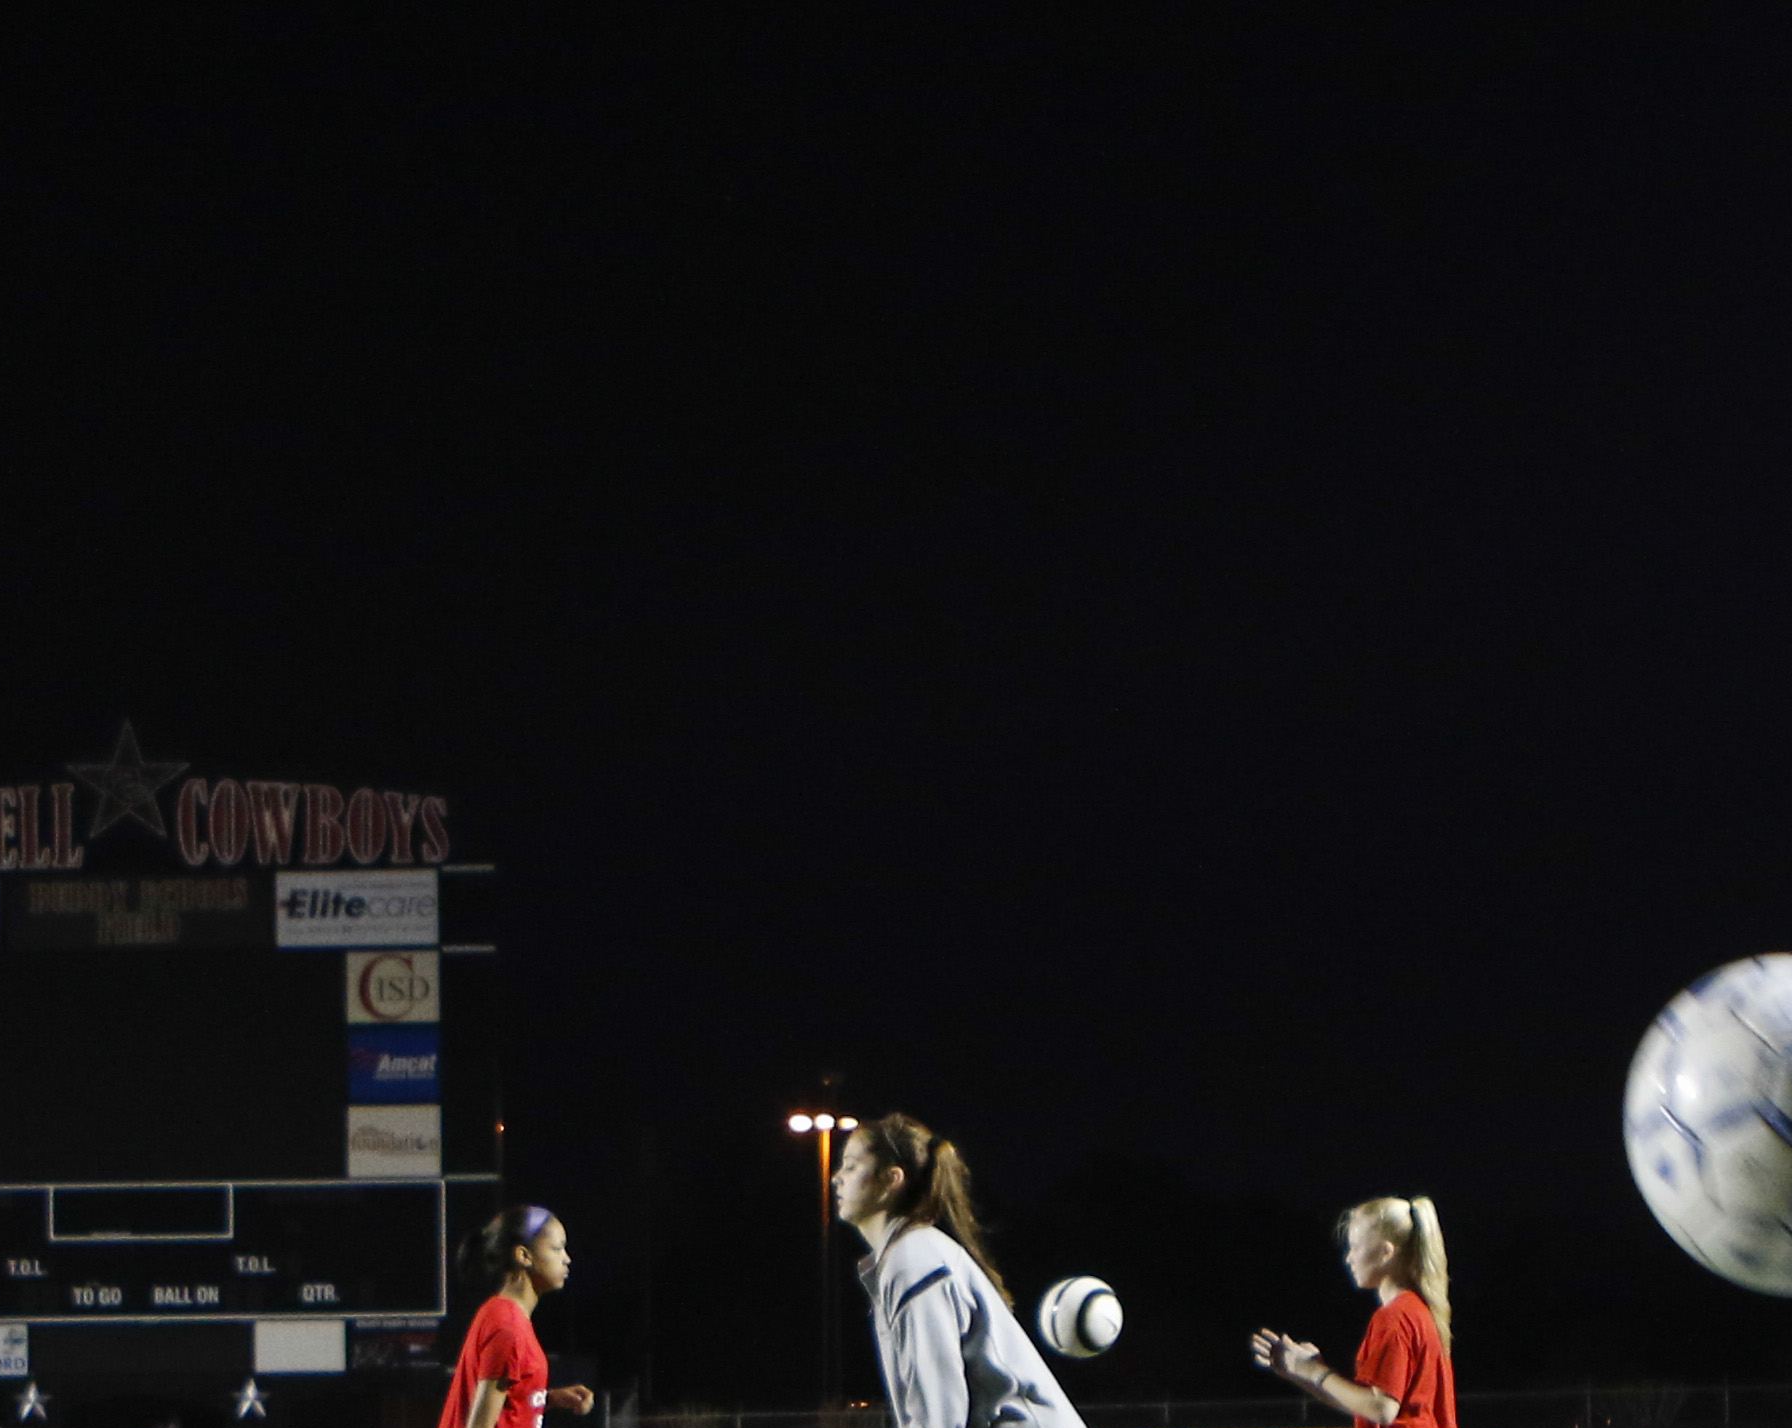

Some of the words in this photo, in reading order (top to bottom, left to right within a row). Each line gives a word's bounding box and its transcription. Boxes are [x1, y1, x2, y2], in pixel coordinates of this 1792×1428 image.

[177, 778, 449, 866] COWBOYS
[72, 1287, 93, 1306] TO
[98, 1286, 122, 1305] GO
[153, 1286, 191, 1305] BALL
[197, 1285, 220, 1304] ON
[301, 1283, 340, 1303] QTR.
